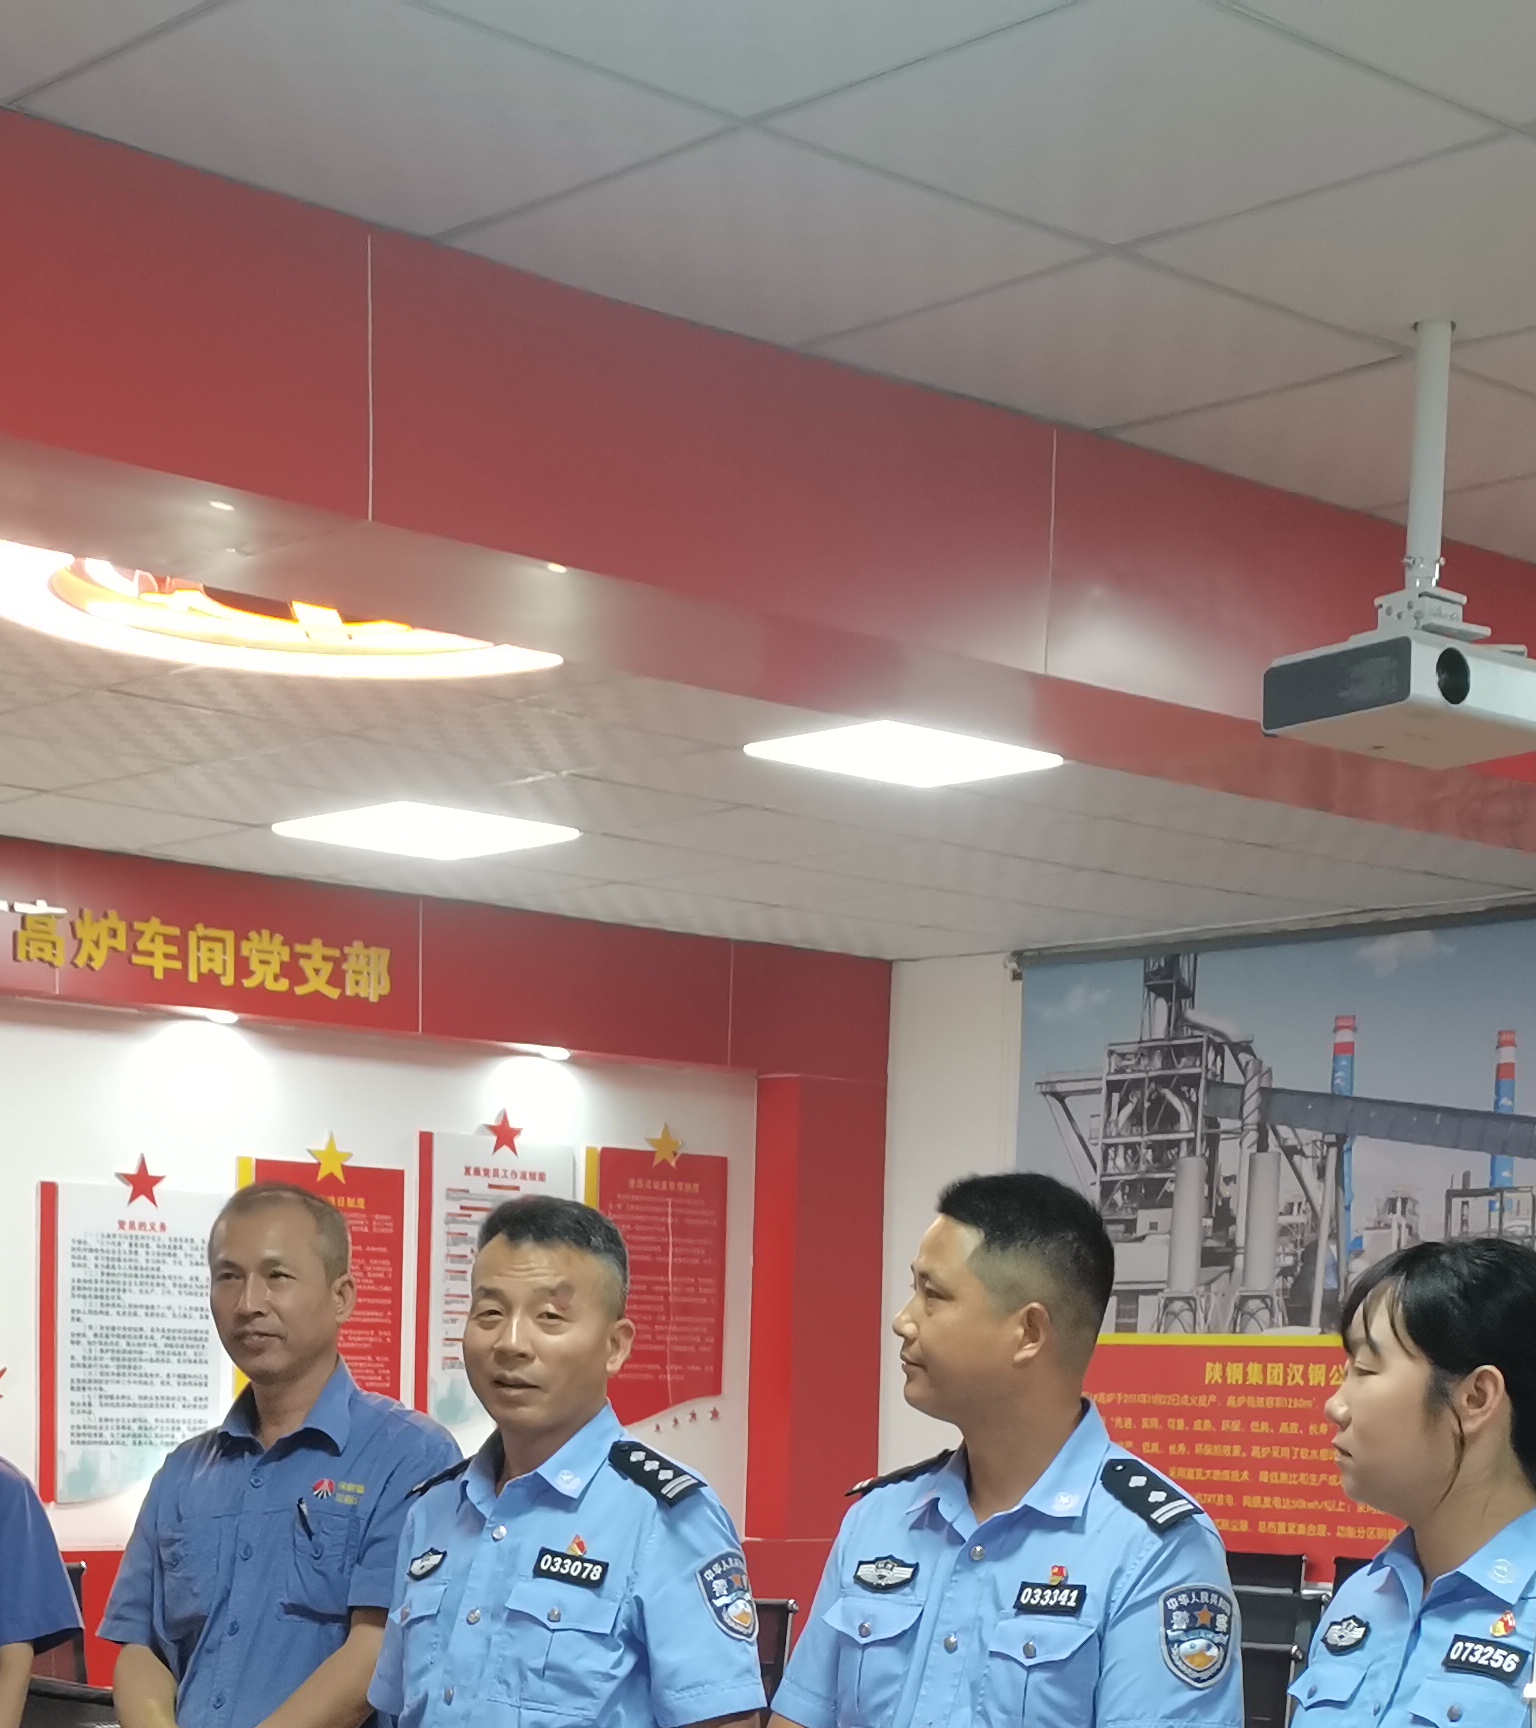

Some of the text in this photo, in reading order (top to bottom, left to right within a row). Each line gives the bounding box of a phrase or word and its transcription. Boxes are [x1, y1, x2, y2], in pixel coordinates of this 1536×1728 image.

[540, 1554, 603, 1581] 033078
[1020, 1586, 1080, 1608] 033341
[1450, 1641, 1520, 1672] 073256
